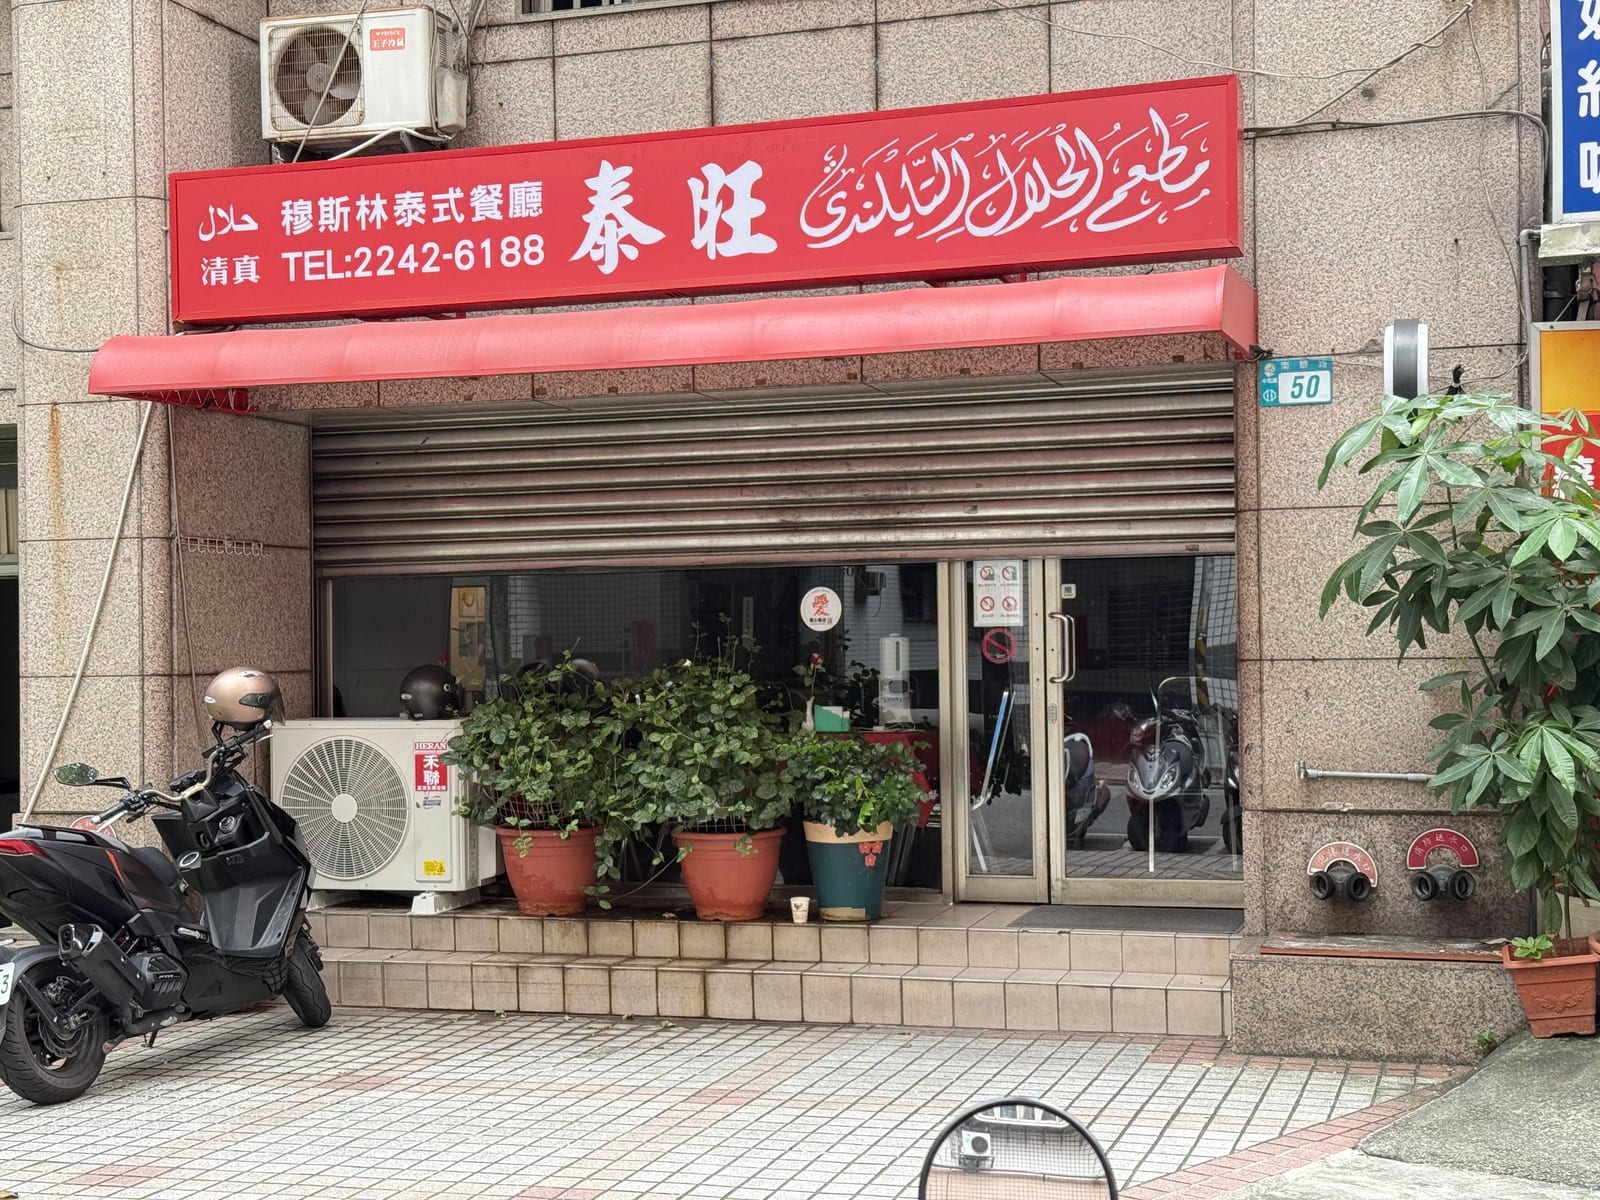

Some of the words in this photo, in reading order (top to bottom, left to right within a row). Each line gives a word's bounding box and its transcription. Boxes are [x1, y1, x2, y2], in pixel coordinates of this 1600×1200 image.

[198, 203, 259, 242] حلال
[280, 180, 544, 237] 穆斯林泰式餐廳
[568, 159, 778, 275] 泰旺
[200, 254, 261, 286] 清真
[280, 233, 545, 283] TEL:2242-6188
[1290, 374, 1321, 399] 50
[415, 742, 447, 750] HERAN
[423, 754, 440, 786] 禾聯
